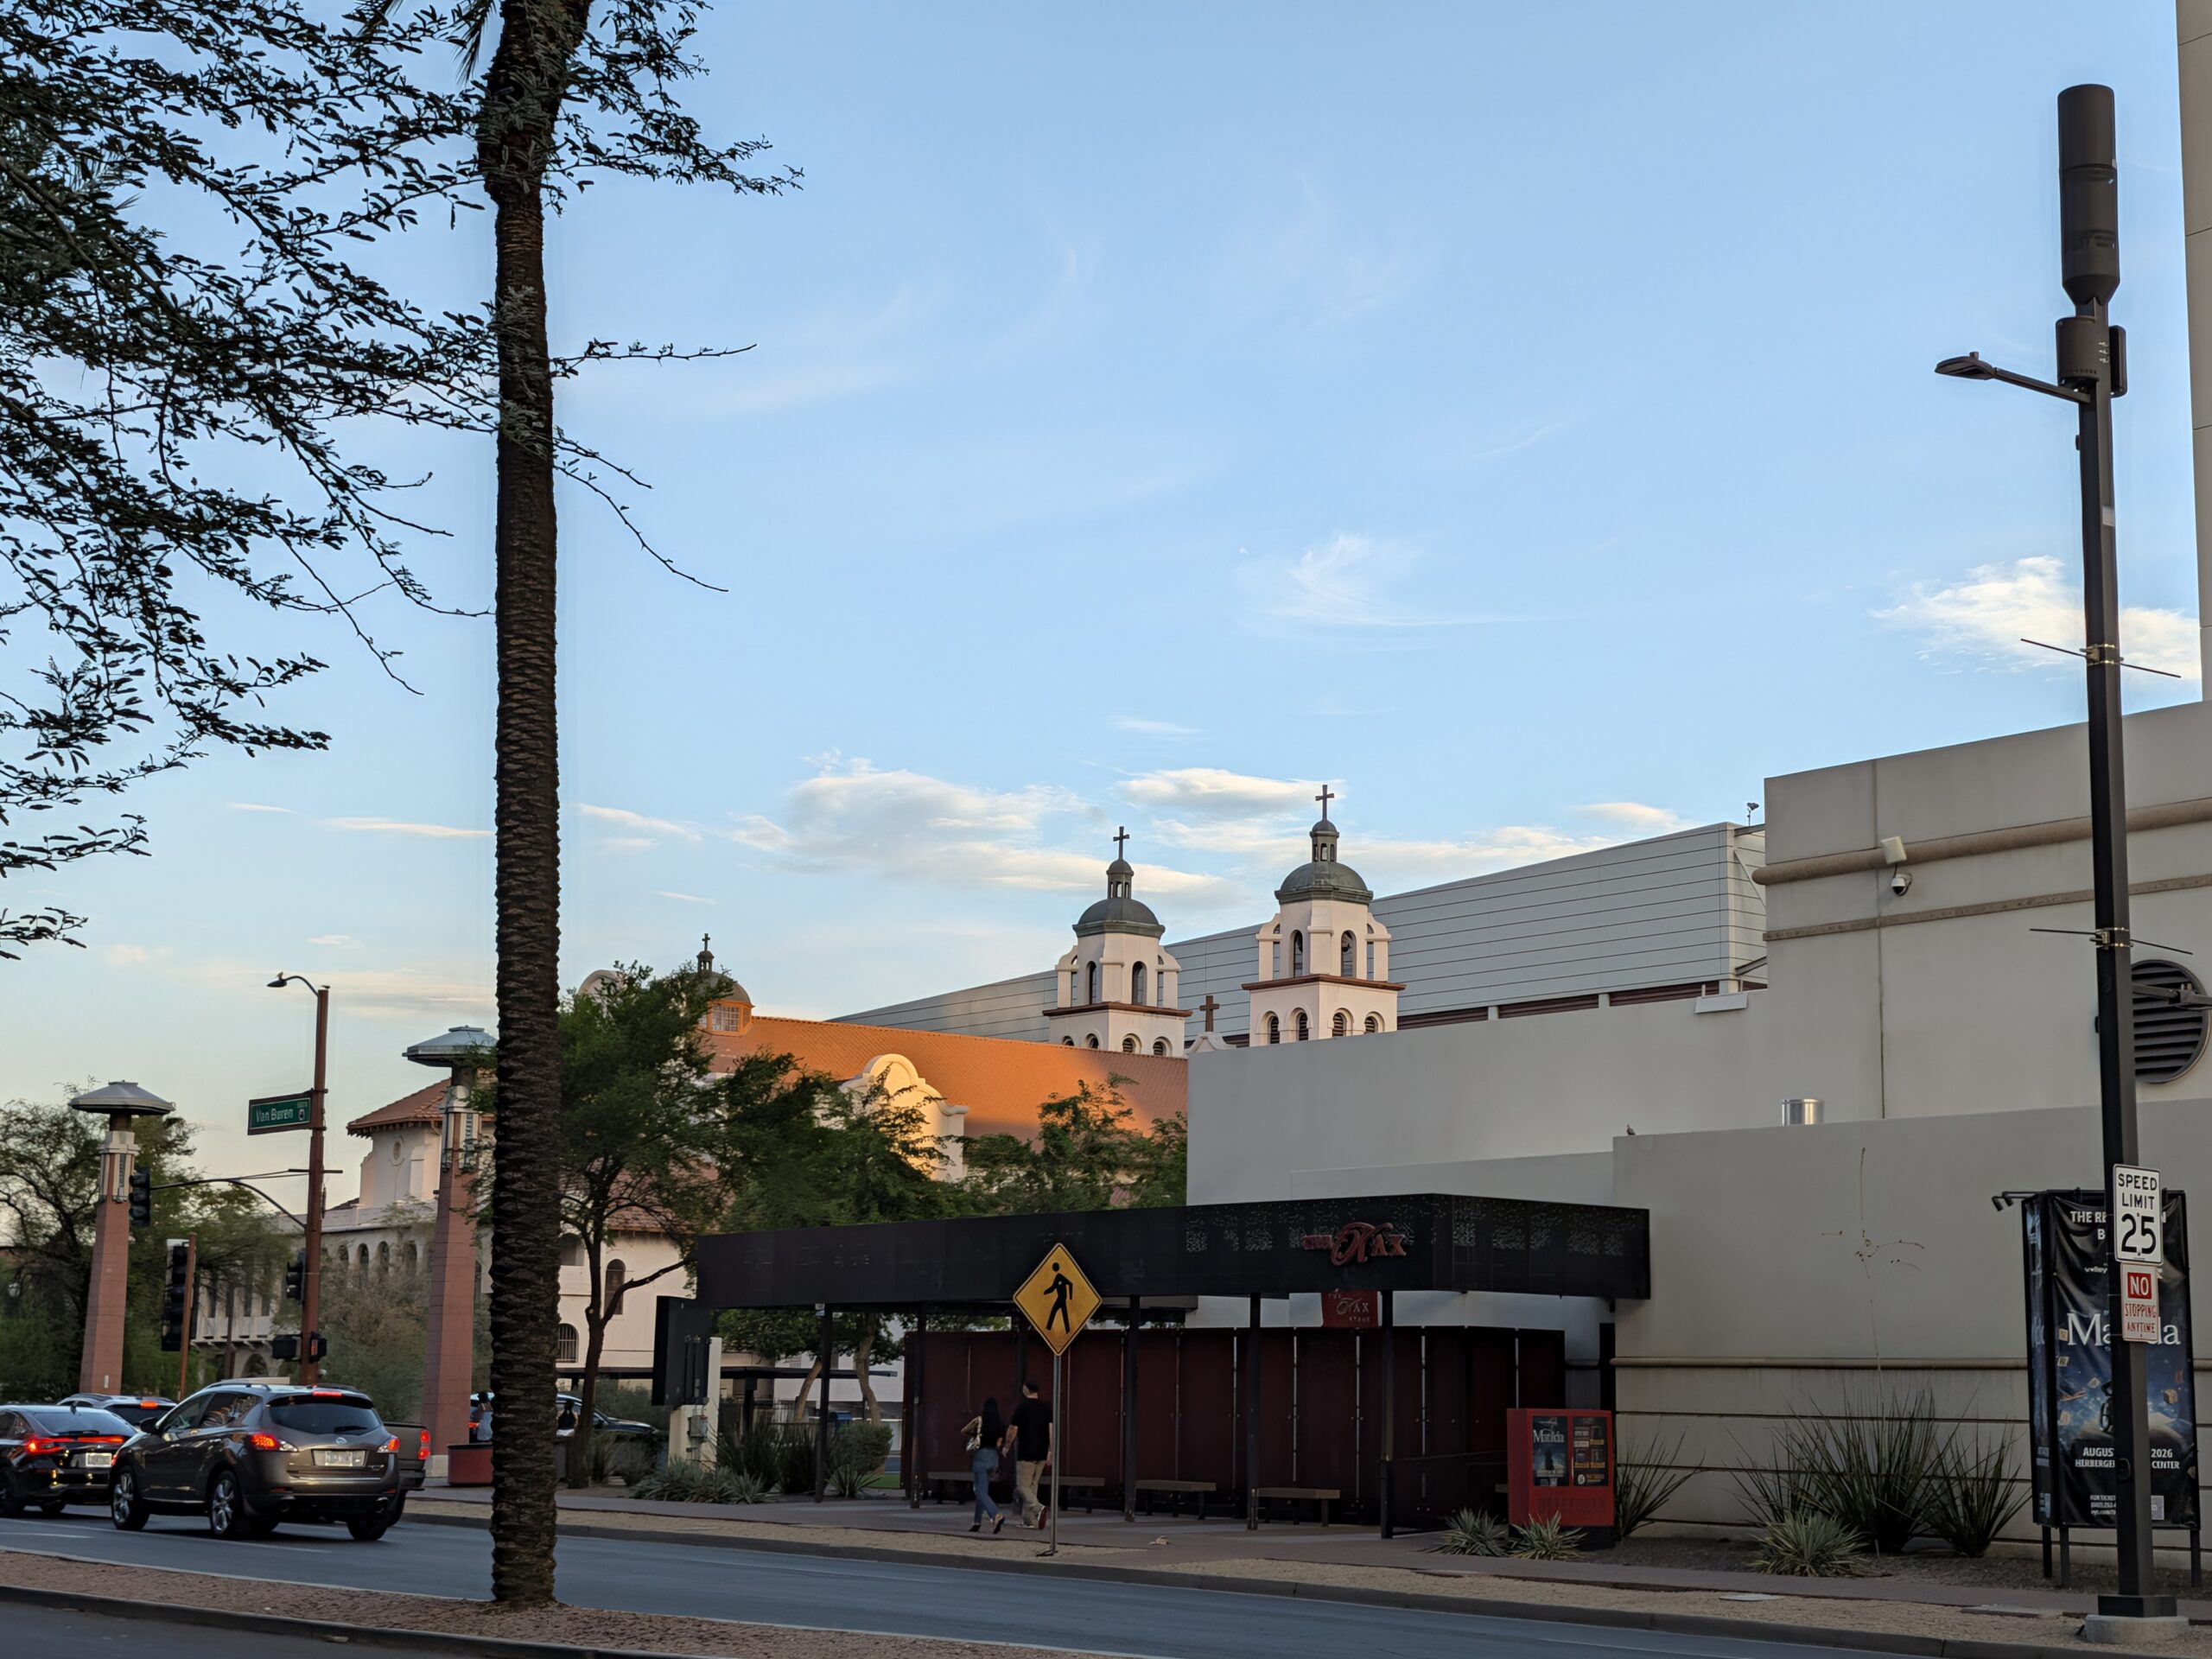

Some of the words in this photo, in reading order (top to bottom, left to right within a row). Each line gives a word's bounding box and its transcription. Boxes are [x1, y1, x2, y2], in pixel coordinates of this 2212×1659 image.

[256, 1109, 270, 1122] Van
[2118, 1173, 2158, 1191] SPEED
[2122, 1192, 2155, 1210] LIMIT
[2070, 1211, 2093, 1224] THE
[2121, 1213, 2157, 1255] 25
[2131, 1275, 2149, 1296] NO
[2125, 1303, 2156, 1318] STOPPING
[2127, 1322, 2155, 1333] ANYTIME
[2082, 1447, 2114, 1457] AUGUS
[2151, 1448, 2173, 1459] 2026
[2152, 1459, 2180, 1469] CENTER
